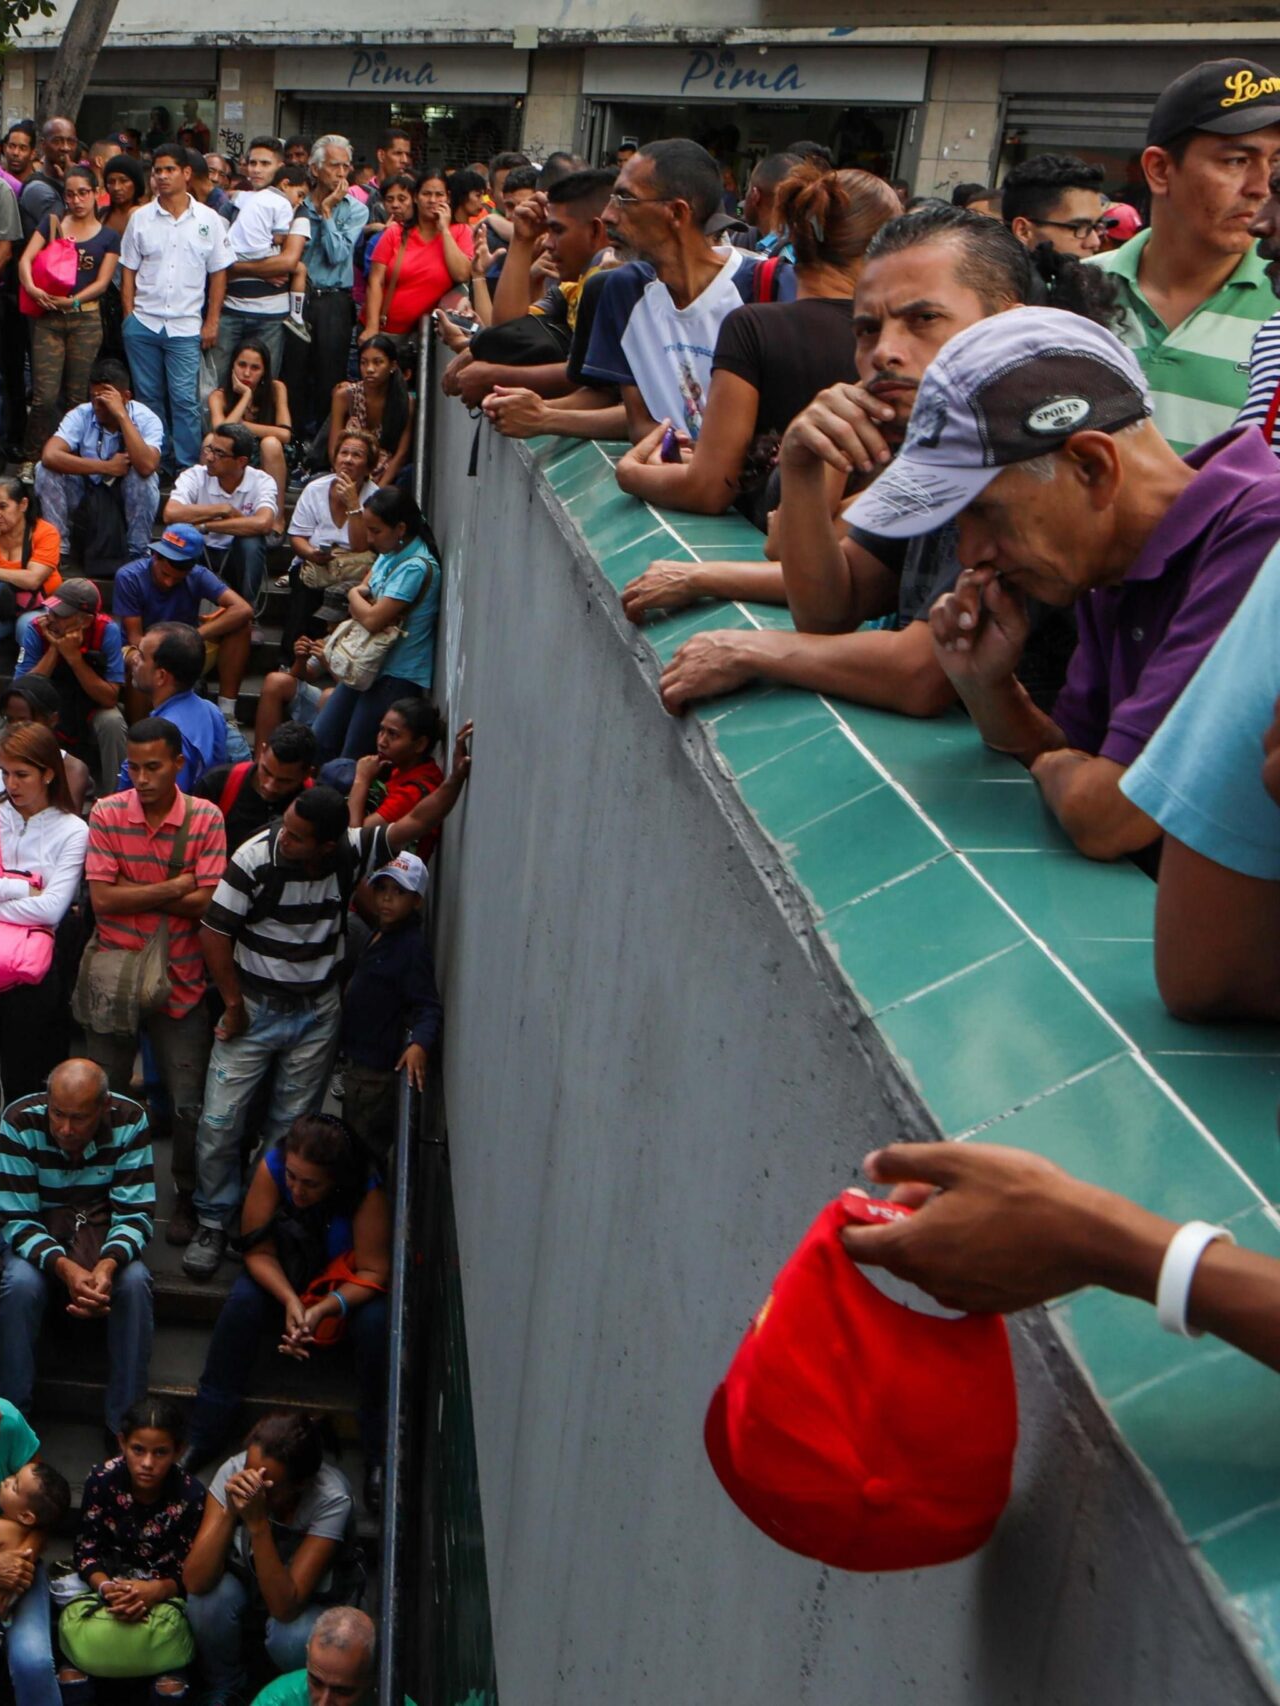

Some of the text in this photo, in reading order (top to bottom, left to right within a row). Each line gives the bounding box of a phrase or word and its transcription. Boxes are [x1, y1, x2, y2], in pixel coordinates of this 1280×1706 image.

[348, 51, 438, 88] Pima
[681, 50, 806, 93] Pima
[1036, 401, 1080, 422] SPORTS
